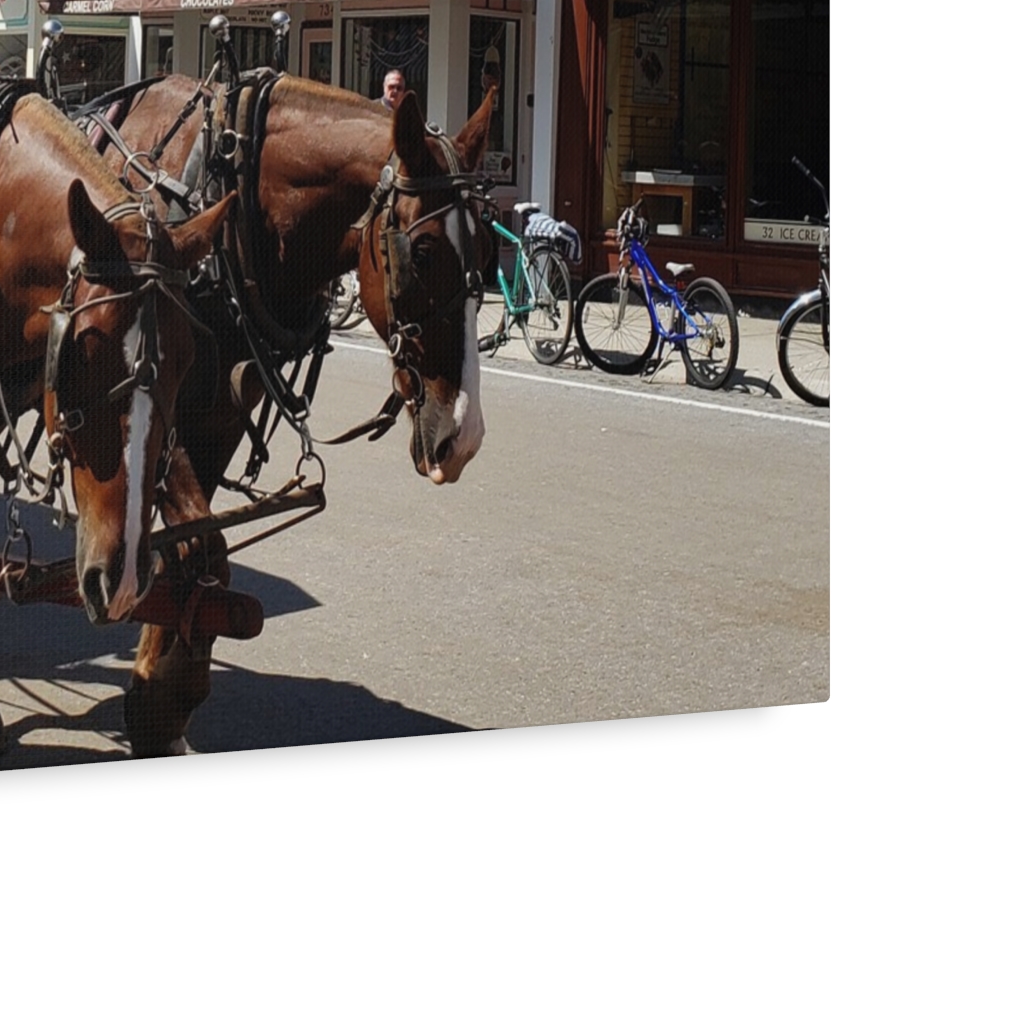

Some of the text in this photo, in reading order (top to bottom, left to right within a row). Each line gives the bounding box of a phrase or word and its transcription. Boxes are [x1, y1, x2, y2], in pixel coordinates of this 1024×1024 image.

[762, 226, 829, 242] 32 ICE CRE
